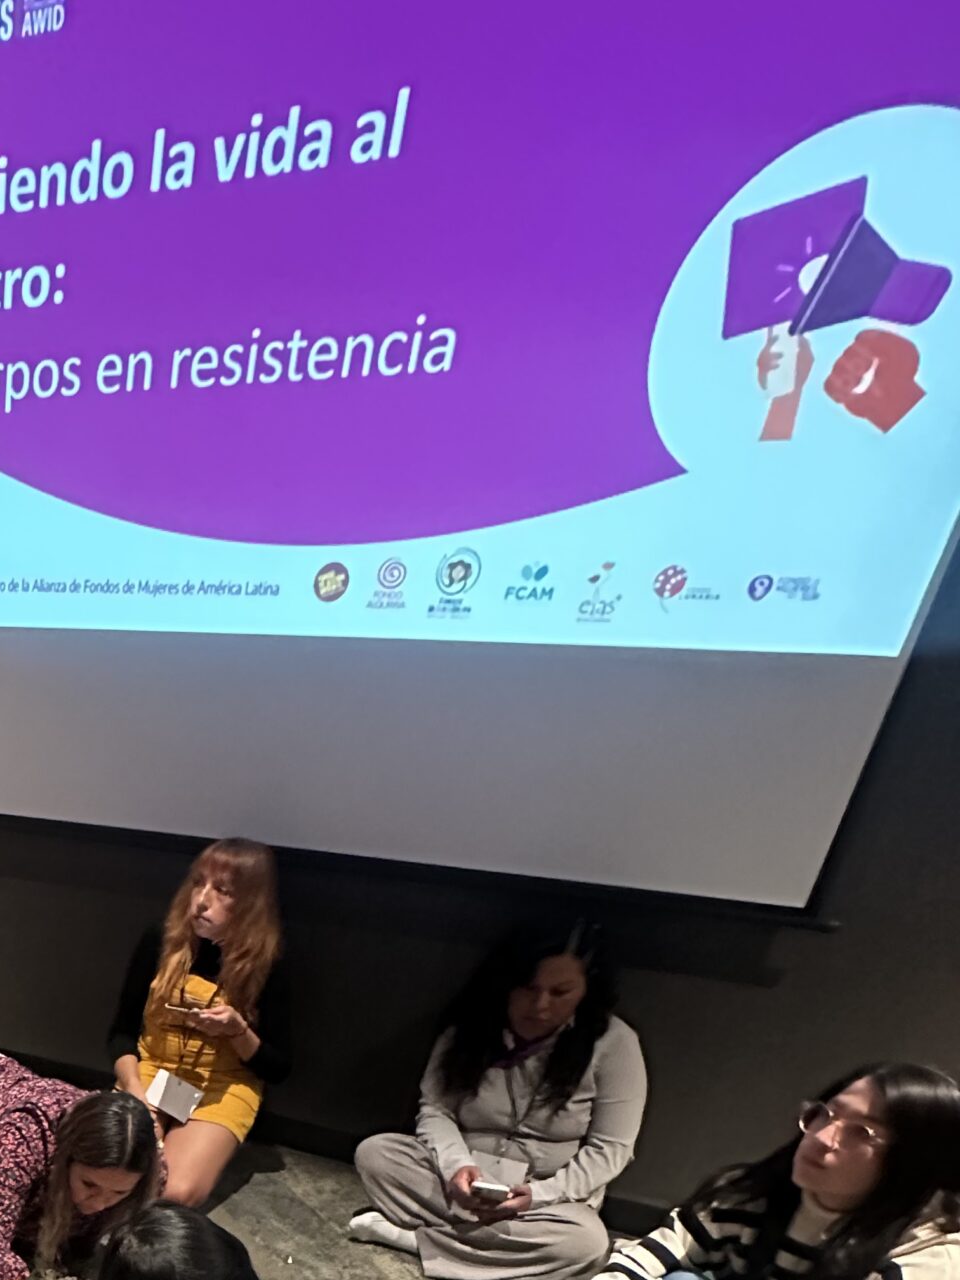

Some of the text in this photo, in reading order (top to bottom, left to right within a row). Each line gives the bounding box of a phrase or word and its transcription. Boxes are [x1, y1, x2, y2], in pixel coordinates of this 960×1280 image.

[21, 4, 65, 38] AWID
[150, 128, 195, 192] la
[214, 105, 332, 183] vida
[350, 86, 411, 164] al
[96, 351, 153, 394] en
[170, 313, 457, 389] resistencia
[8, 578, 19, 592] de
[21, 578, 30, 592] la
[32, 579, 67, 593] Alianza
[69, 579, 81, 593] de
[83, 579, 120, 594] Fondos
[122, 579, 136, 594] de
[137, 580, 179, 597] Mujeres
[182, 580, 195, 595] de
[197, 580, 242, 596] América
[244, 581, 280, 596] Latina
[504, 586, 554, 601] FCAM
